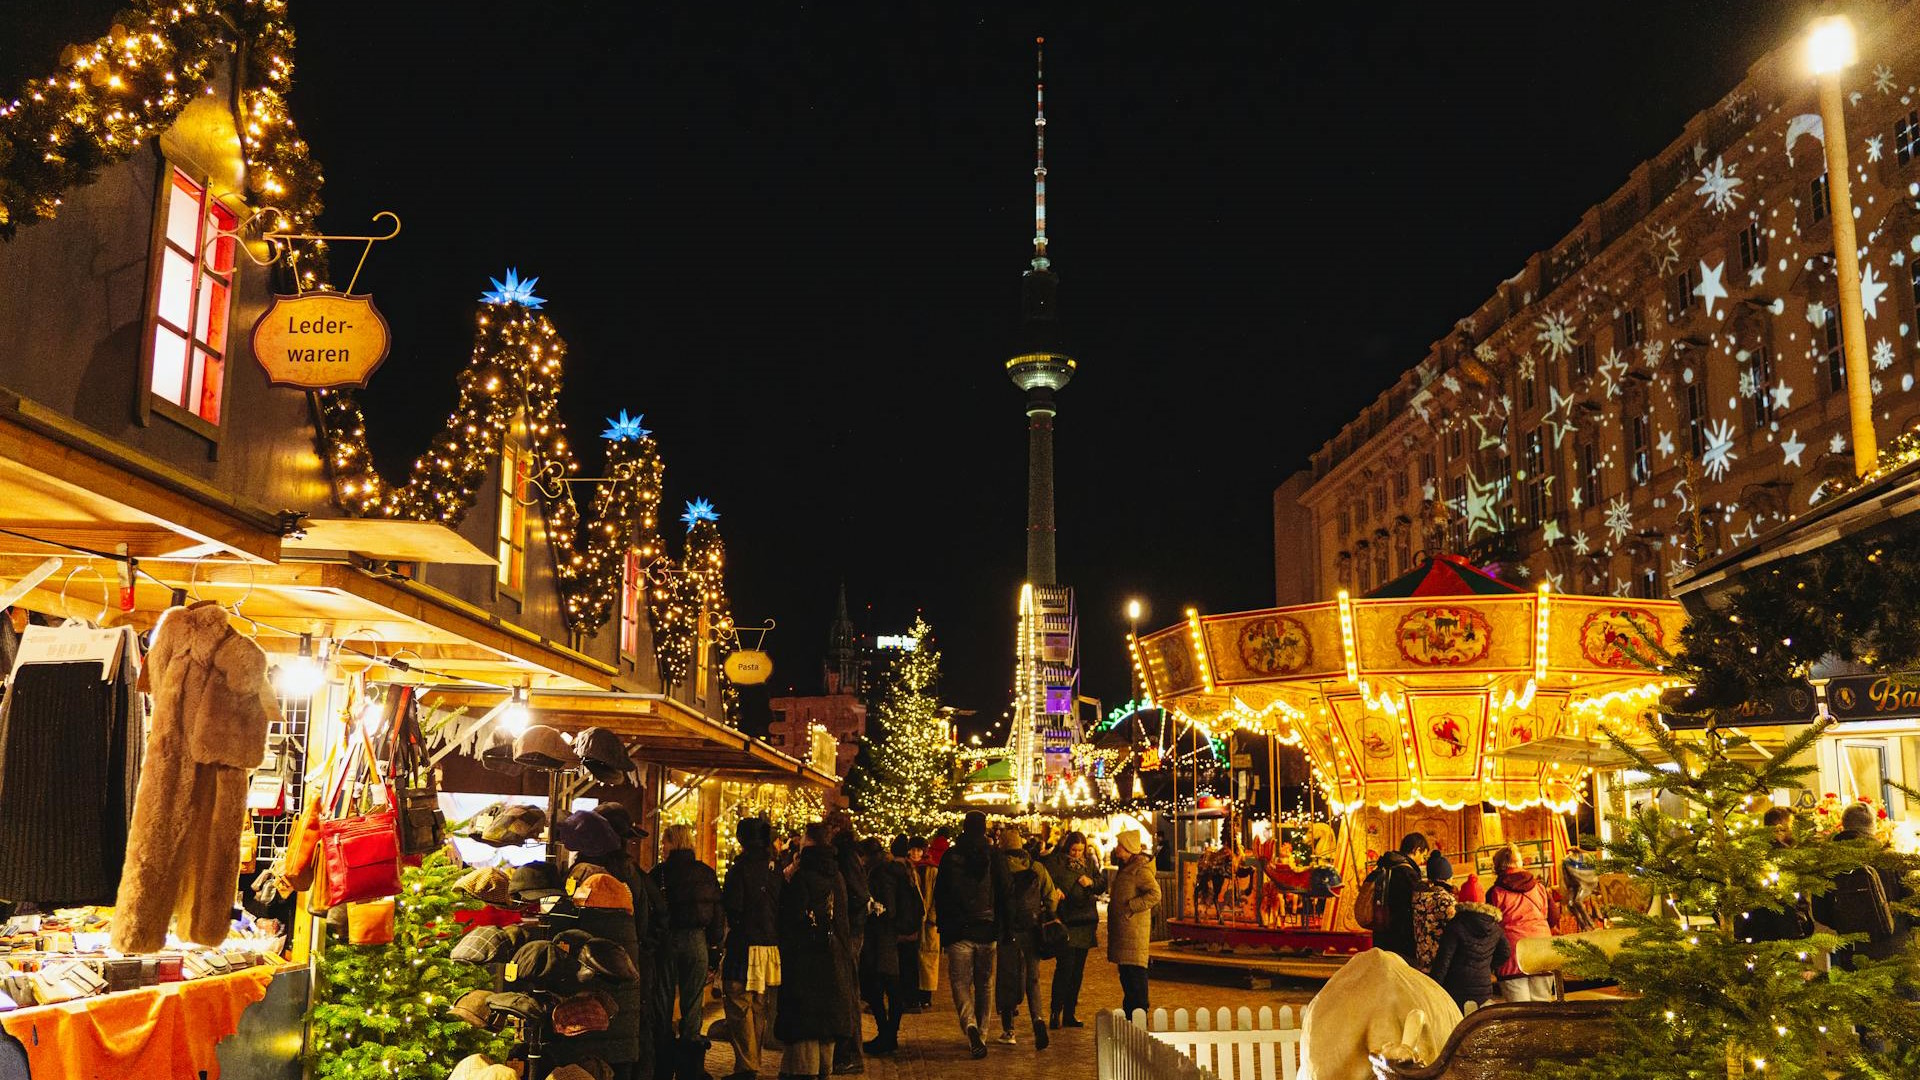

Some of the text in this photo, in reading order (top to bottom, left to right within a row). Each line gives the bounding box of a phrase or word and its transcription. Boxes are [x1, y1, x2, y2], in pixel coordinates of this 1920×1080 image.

[288, 315, 353, 334] Leder-
[287, 348, 350, 363] waren
[737, 663, 760, 671] Pasta
[1868, 676, 1920, 711] Ba
